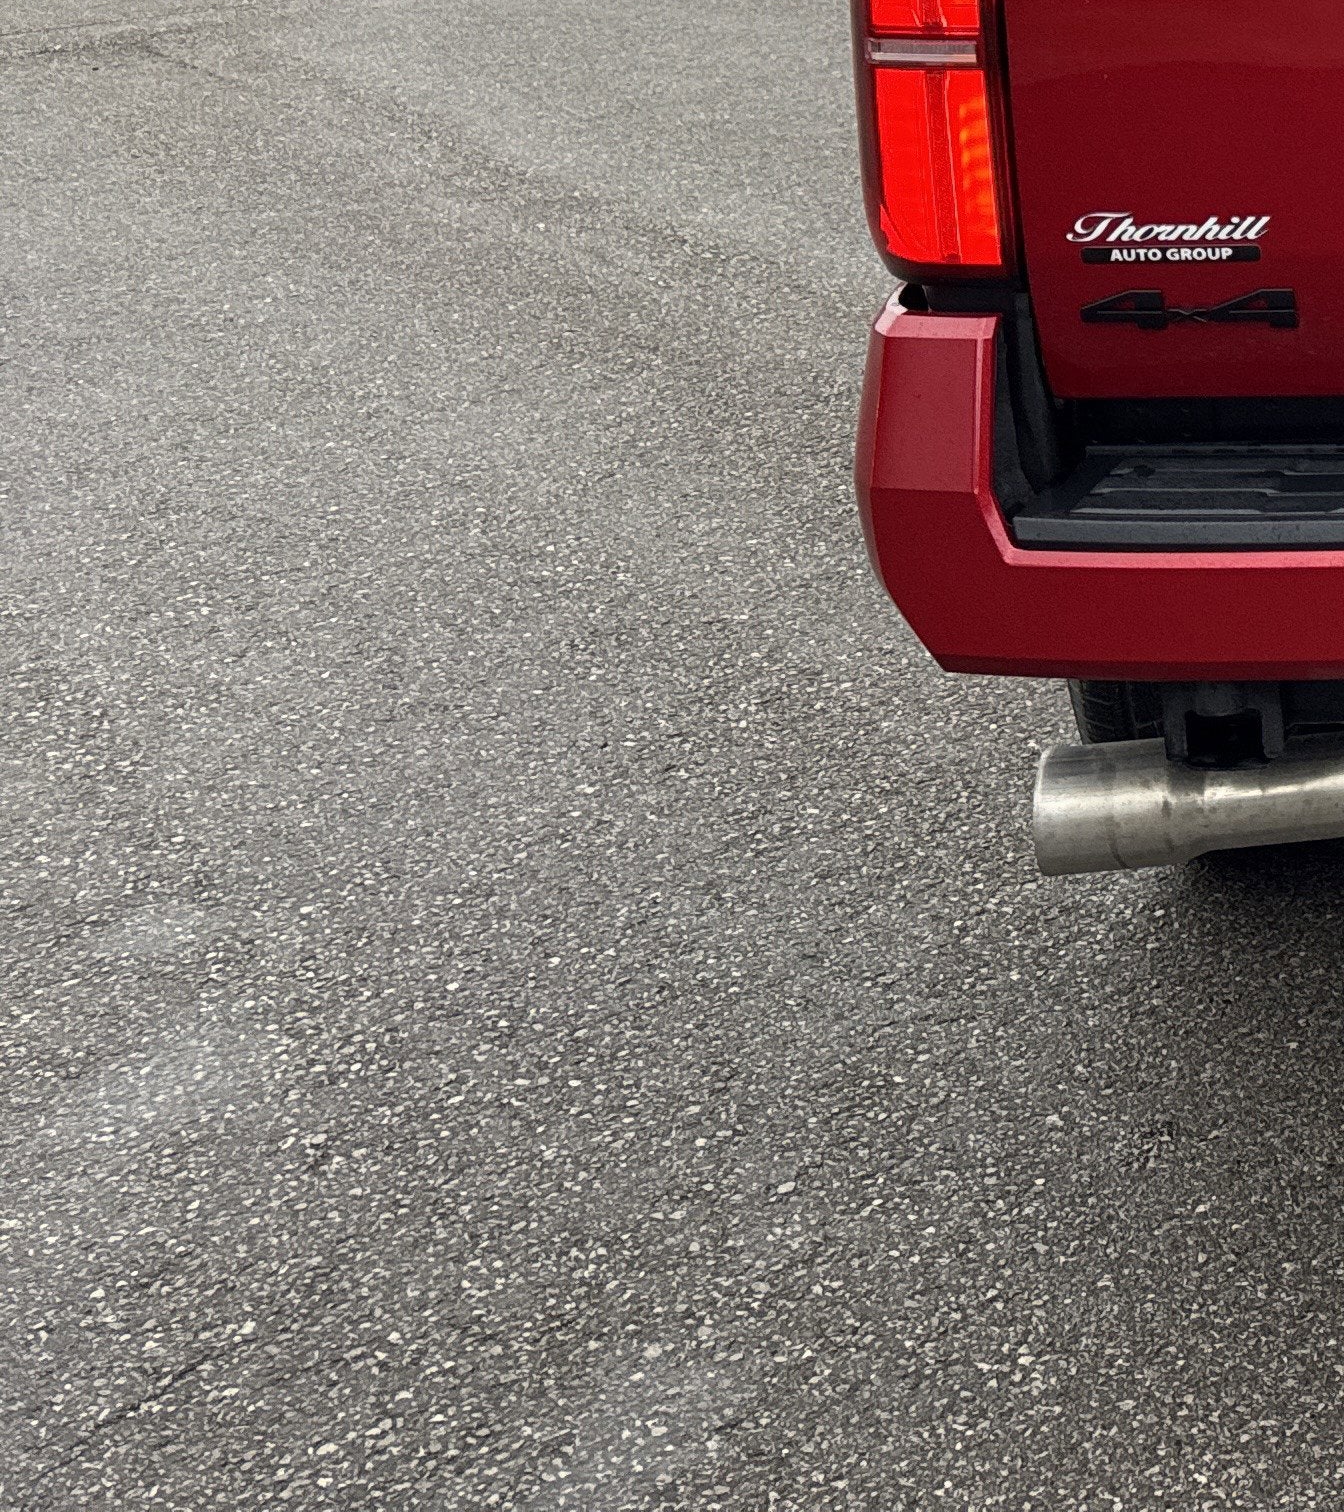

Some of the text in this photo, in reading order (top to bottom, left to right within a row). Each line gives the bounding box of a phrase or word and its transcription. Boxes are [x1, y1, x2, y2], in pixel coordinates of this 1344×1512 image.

[1065, 211, 1271, 243] Thornhill
[1110, 247, 1233, 262] AUTO GROUP
